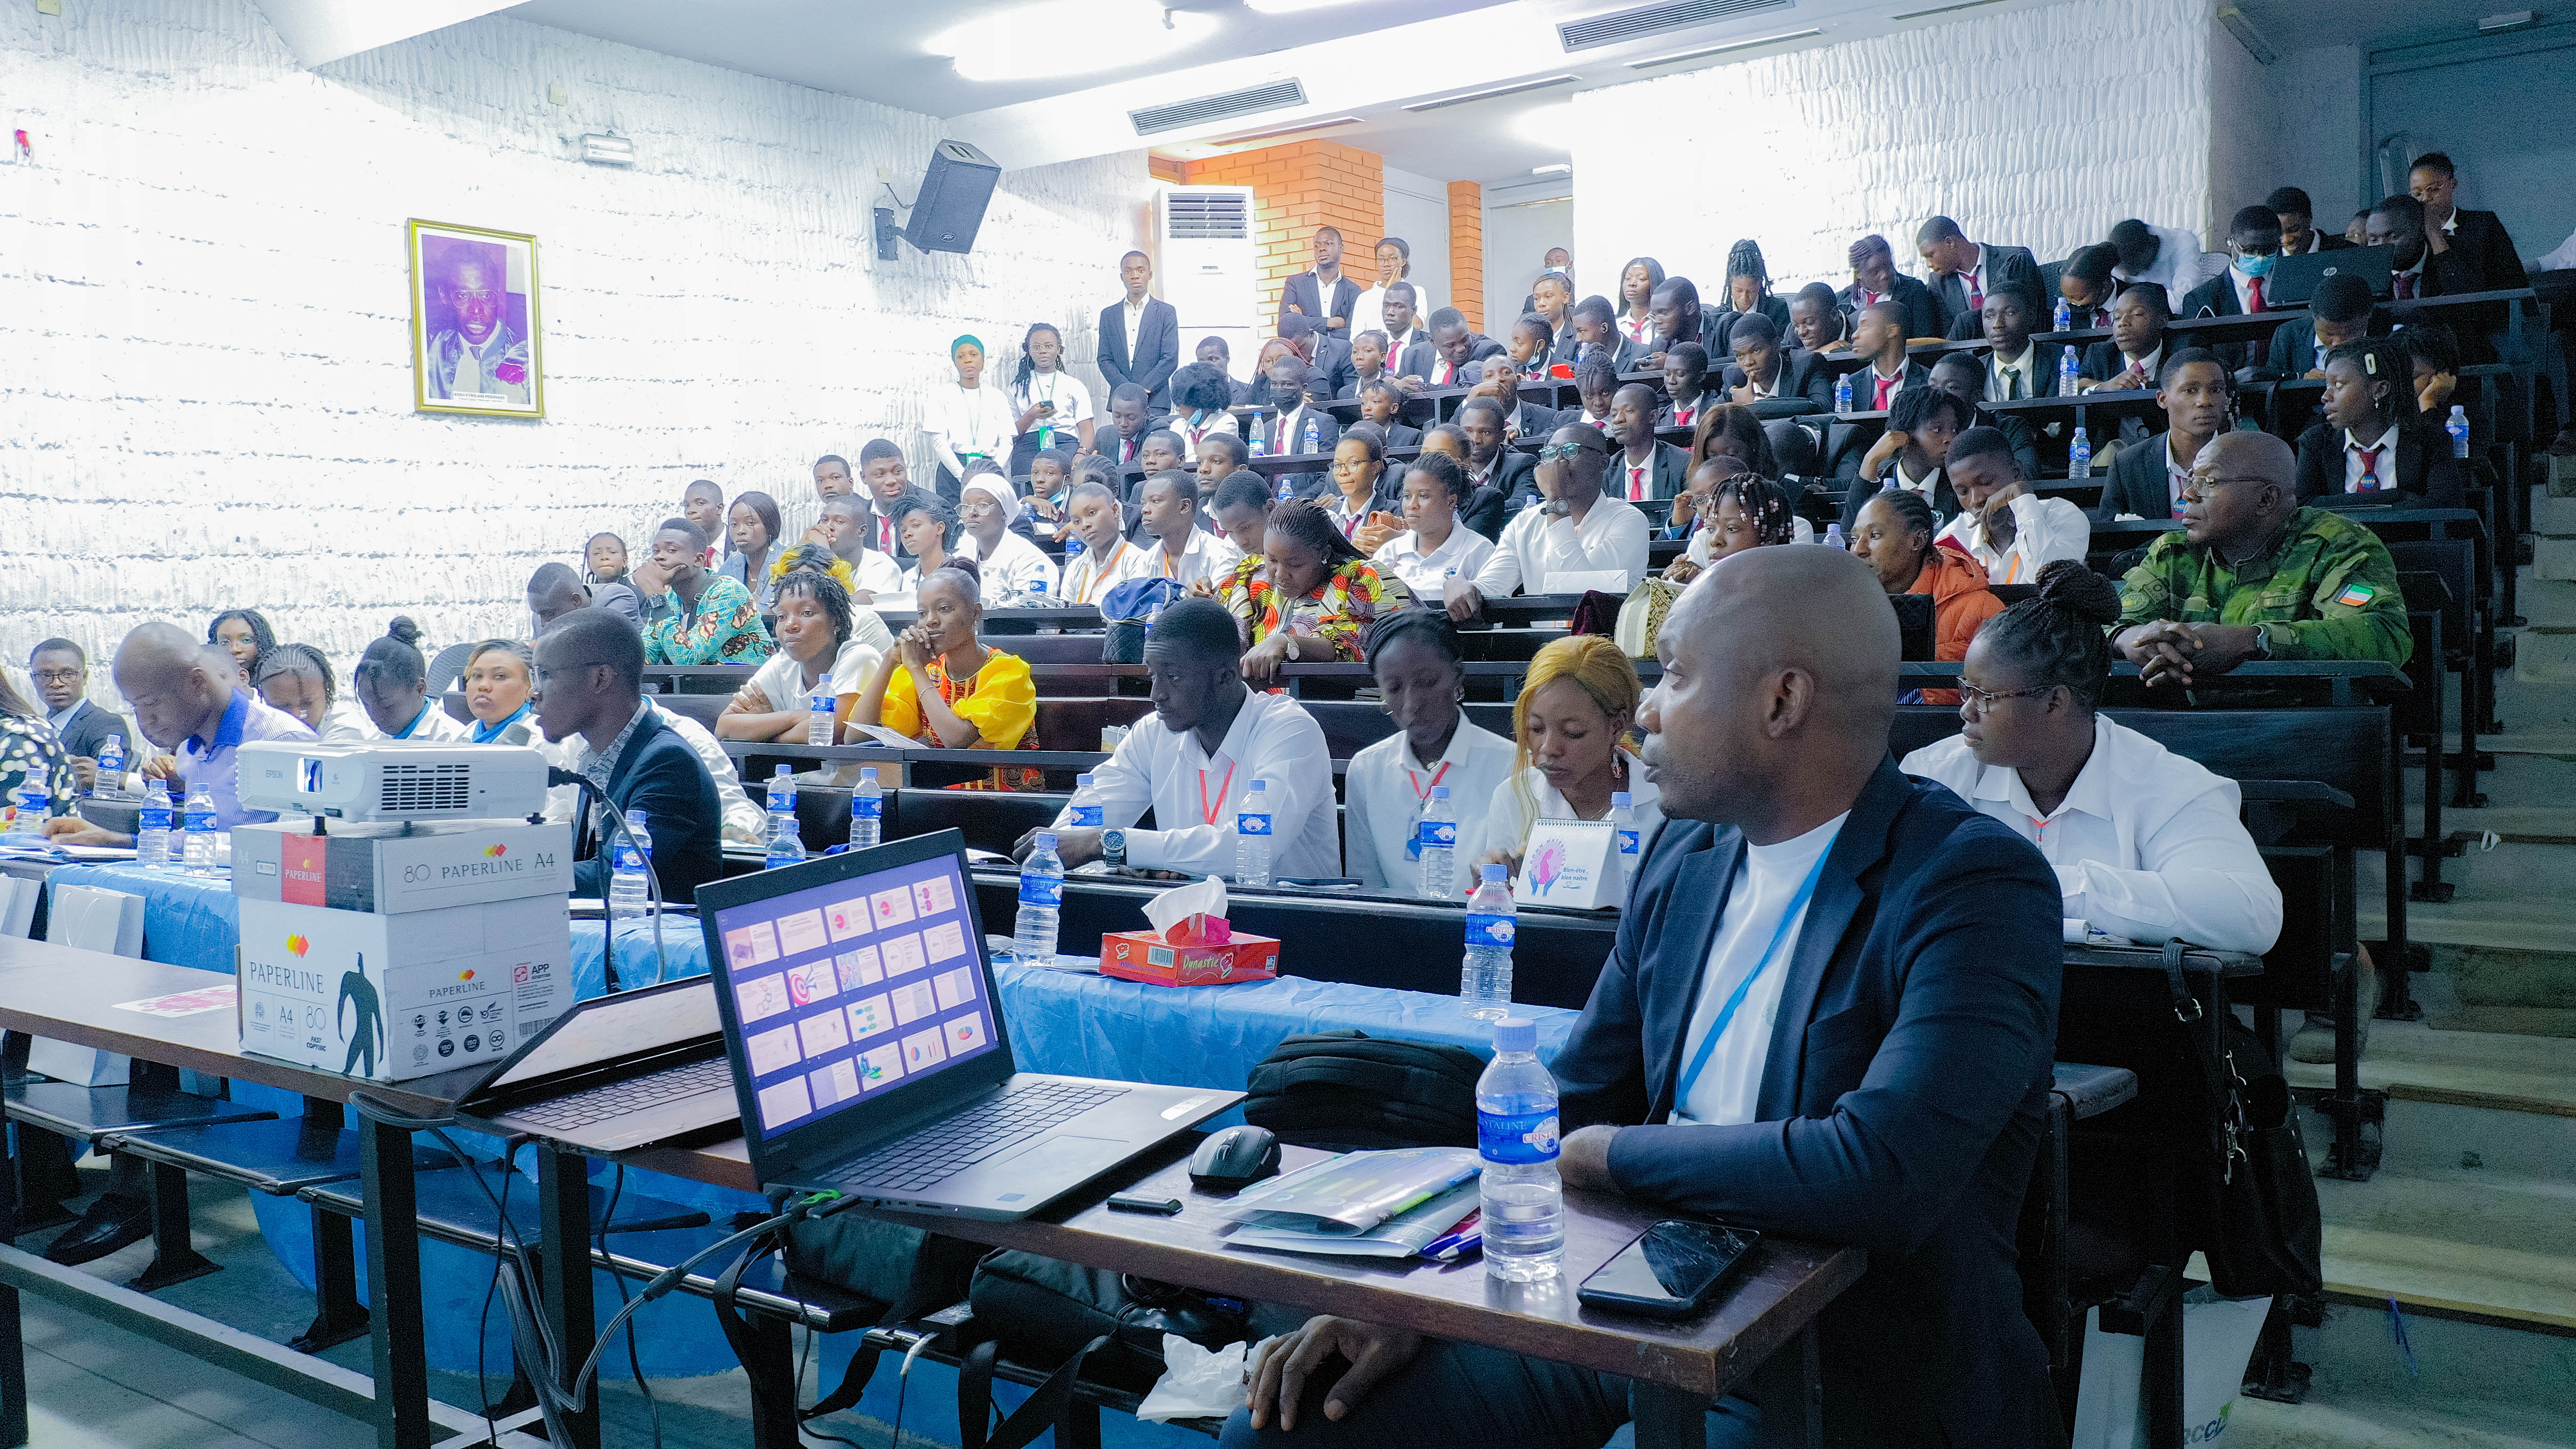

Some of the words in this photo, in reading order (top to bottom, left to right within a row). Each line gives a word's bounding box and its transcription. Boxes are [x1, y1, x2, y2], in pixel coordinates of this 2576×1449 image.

[266, 770, 282, 779] EPSON
[237, 849, 249, 864] A4
[285, 869, 322, 883] PAPERLINE
[403, 864, 431, 883] 80
[442, 859, 523, 879] PAPERLINE
[535, 853, 555, 869] A4
[531, 964, 549, 974] APP
[1183, 955, 1218, 974] Dynastie
[250, 962, 324, 994] PAPERLINE
[429, 981, 485, 998] PAPERLINE
[280, 1006, 293, 1024] A4
[306, 1006, 326, 1030] 80
